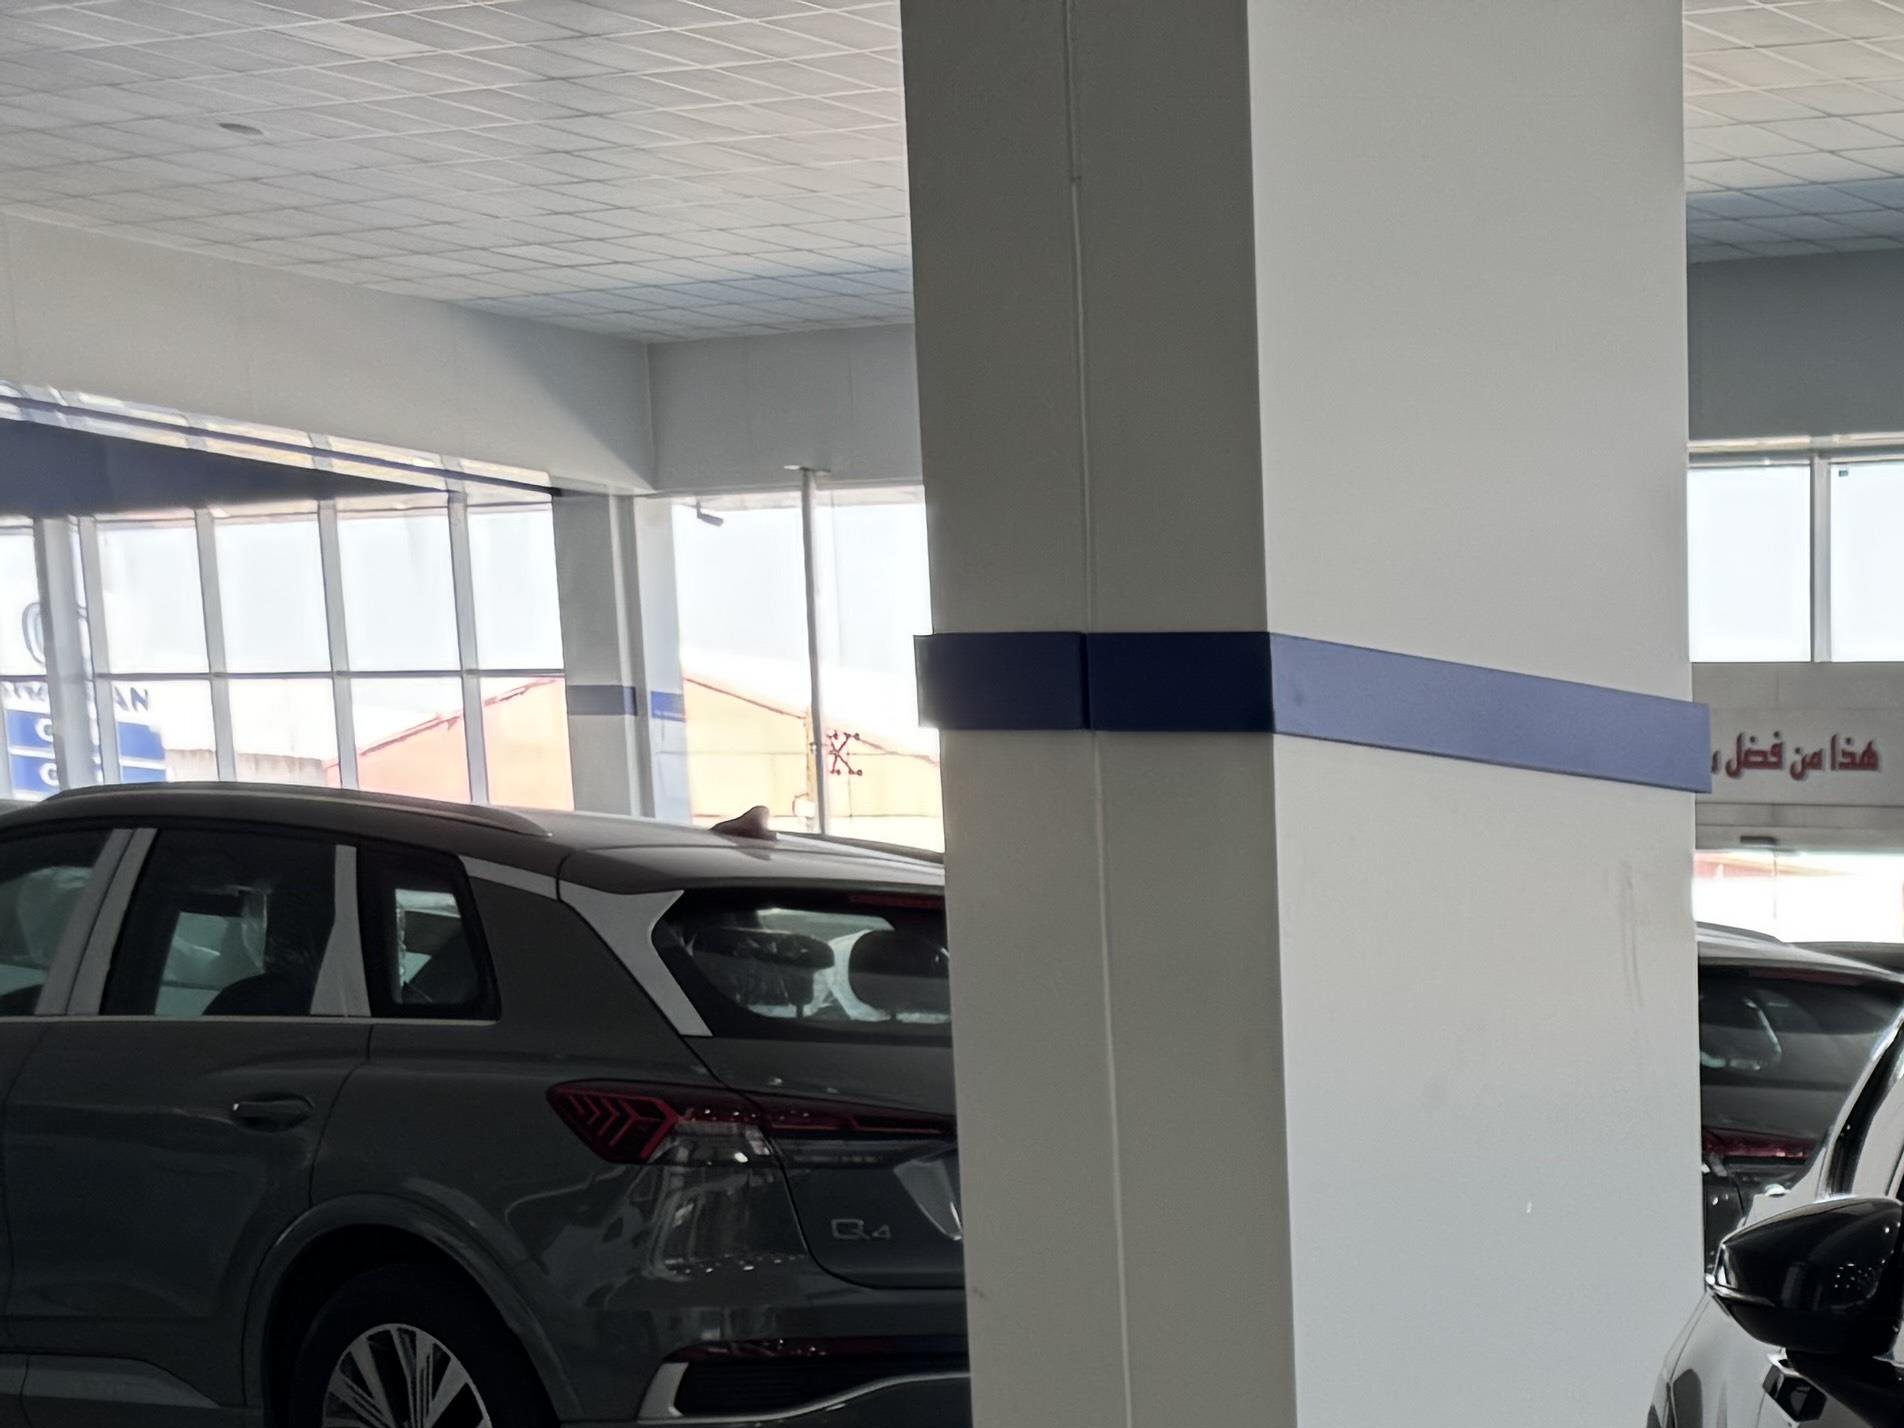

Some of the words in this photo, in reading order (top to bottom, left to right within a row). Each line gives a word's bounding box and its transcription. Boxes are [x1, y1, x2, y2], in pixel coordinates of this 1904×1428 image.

[1725, 731, 1785, 779] فضل
[1790, 747, 1824, 781] من
[1830, 732, 1880, 772] هذا
